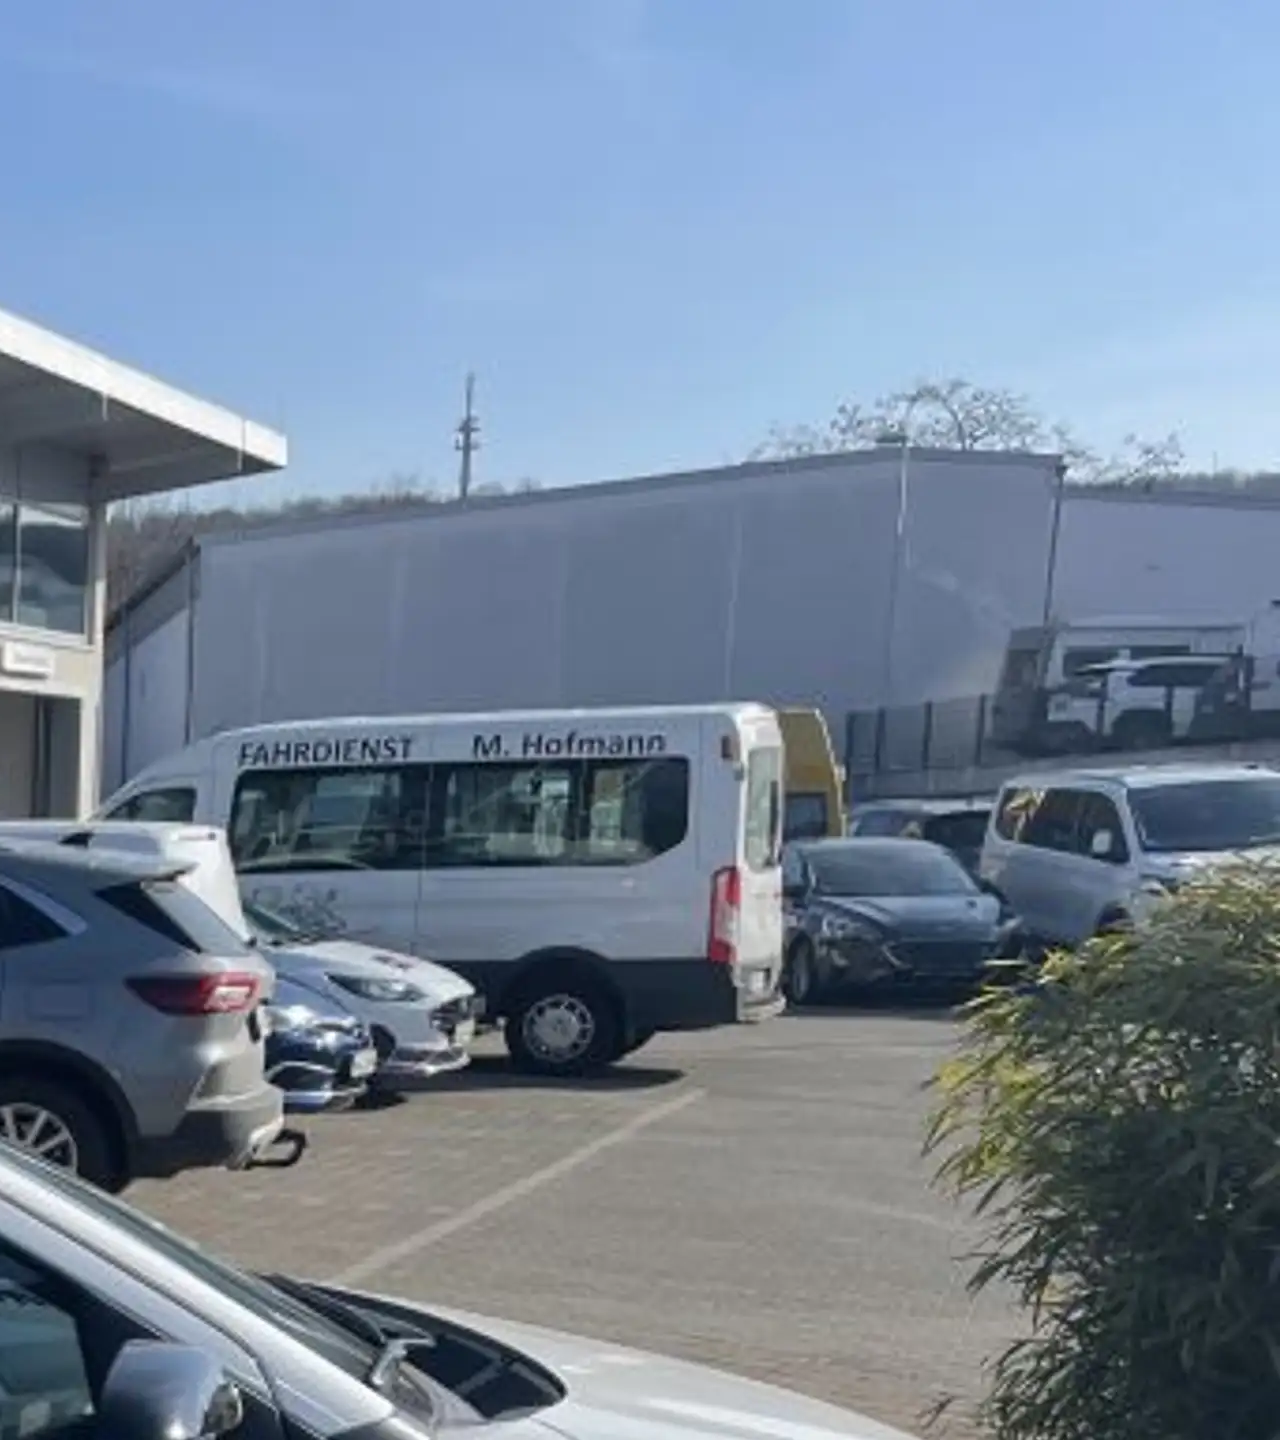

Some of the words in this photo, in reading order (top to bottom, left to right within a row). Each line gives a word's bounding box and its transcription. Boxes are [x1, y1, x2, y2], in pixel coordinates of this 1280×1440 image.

[240, 737, 414, 767] FAHRDIENST
[473, 735, 509, 758] M.
[522, 732, 666, 756] Hofmann
